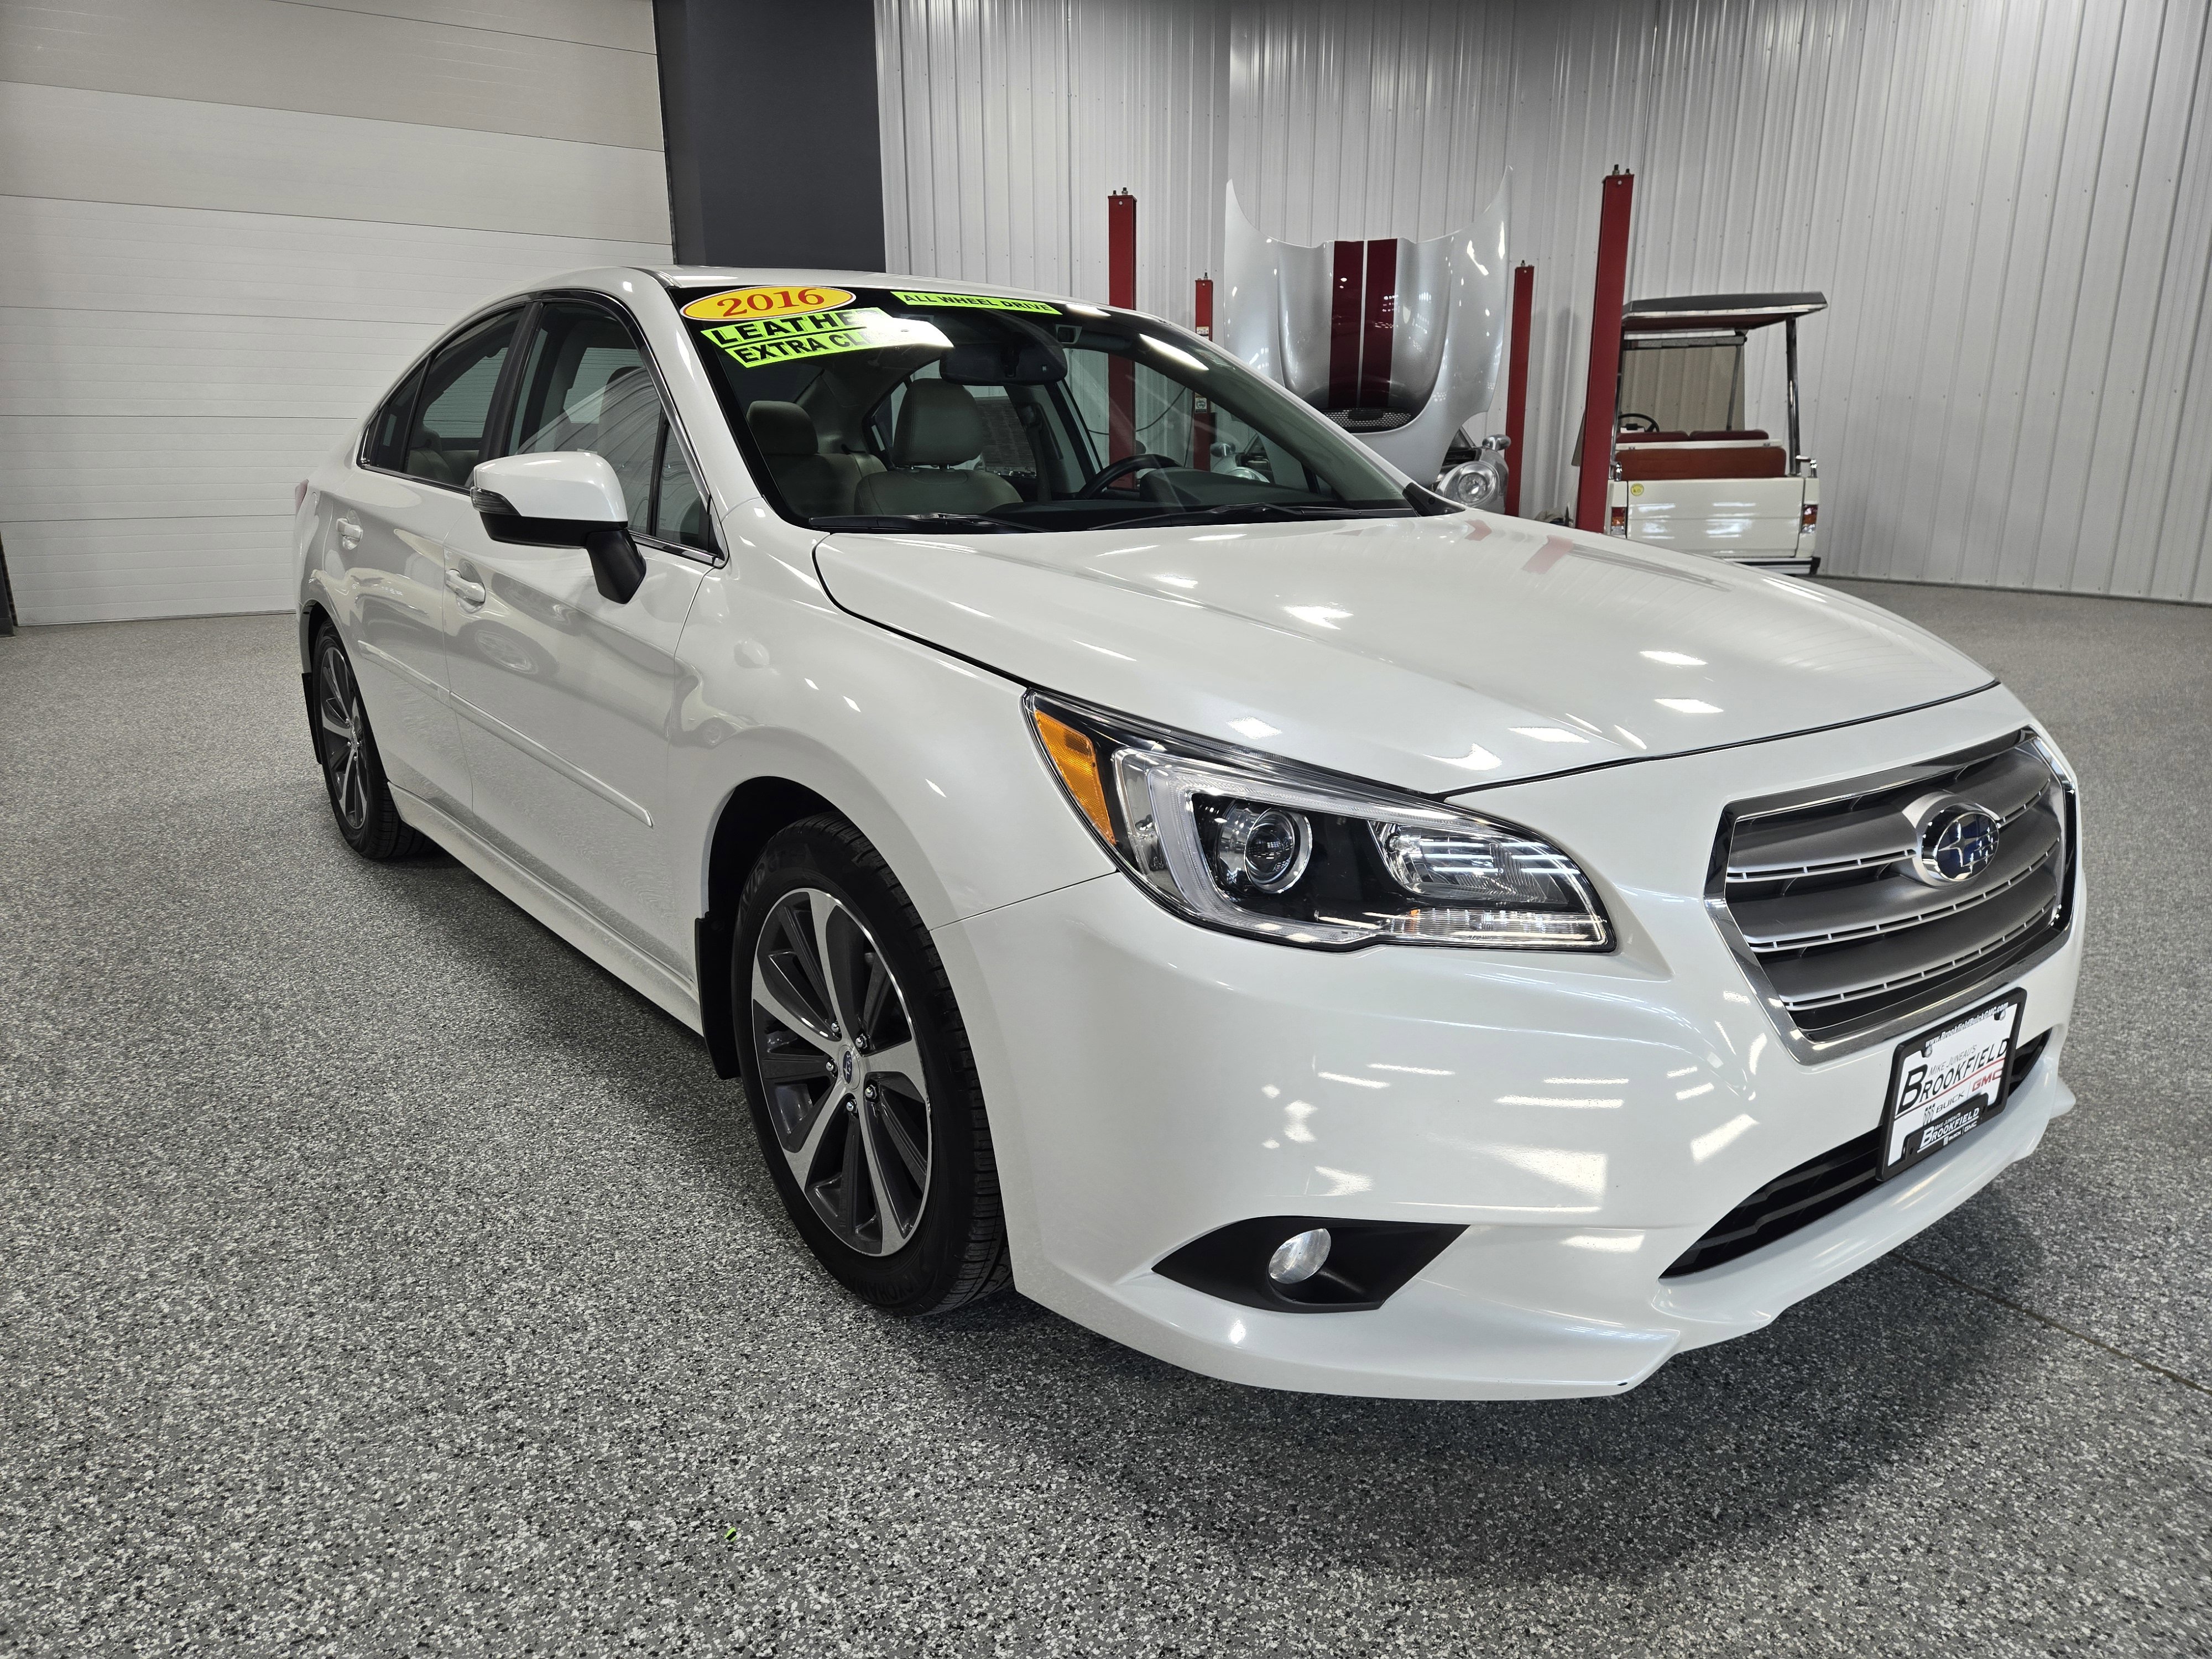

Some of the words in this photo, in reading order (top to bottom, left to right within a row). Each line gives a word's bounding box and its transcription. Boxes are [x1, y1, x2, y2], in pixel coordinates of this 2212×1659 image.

[717, 288, 825, 317] 2016
[903, 294, 937, 303] ALL
[937, 296, 998, 306] WHEEL
[999, 300, 1052, 311] DRIVE
[733, 334, 828, 364] EXTRA
[1925, 1001, 2008, 1047] www.BrookfieldBuickGMC.com
[1897, 1038, 2010, 1116] BROOKFIELD
[1928, 1061, 1947, 1077] MIKE
[1936, 1090, 1965, 1113] BUICK
[1972, 1067, 2002, 1092] GMC
[1919, 1107, 1980, 1149] BROOKFIELD
[1964, 1121, 1978, 1132] GMC
